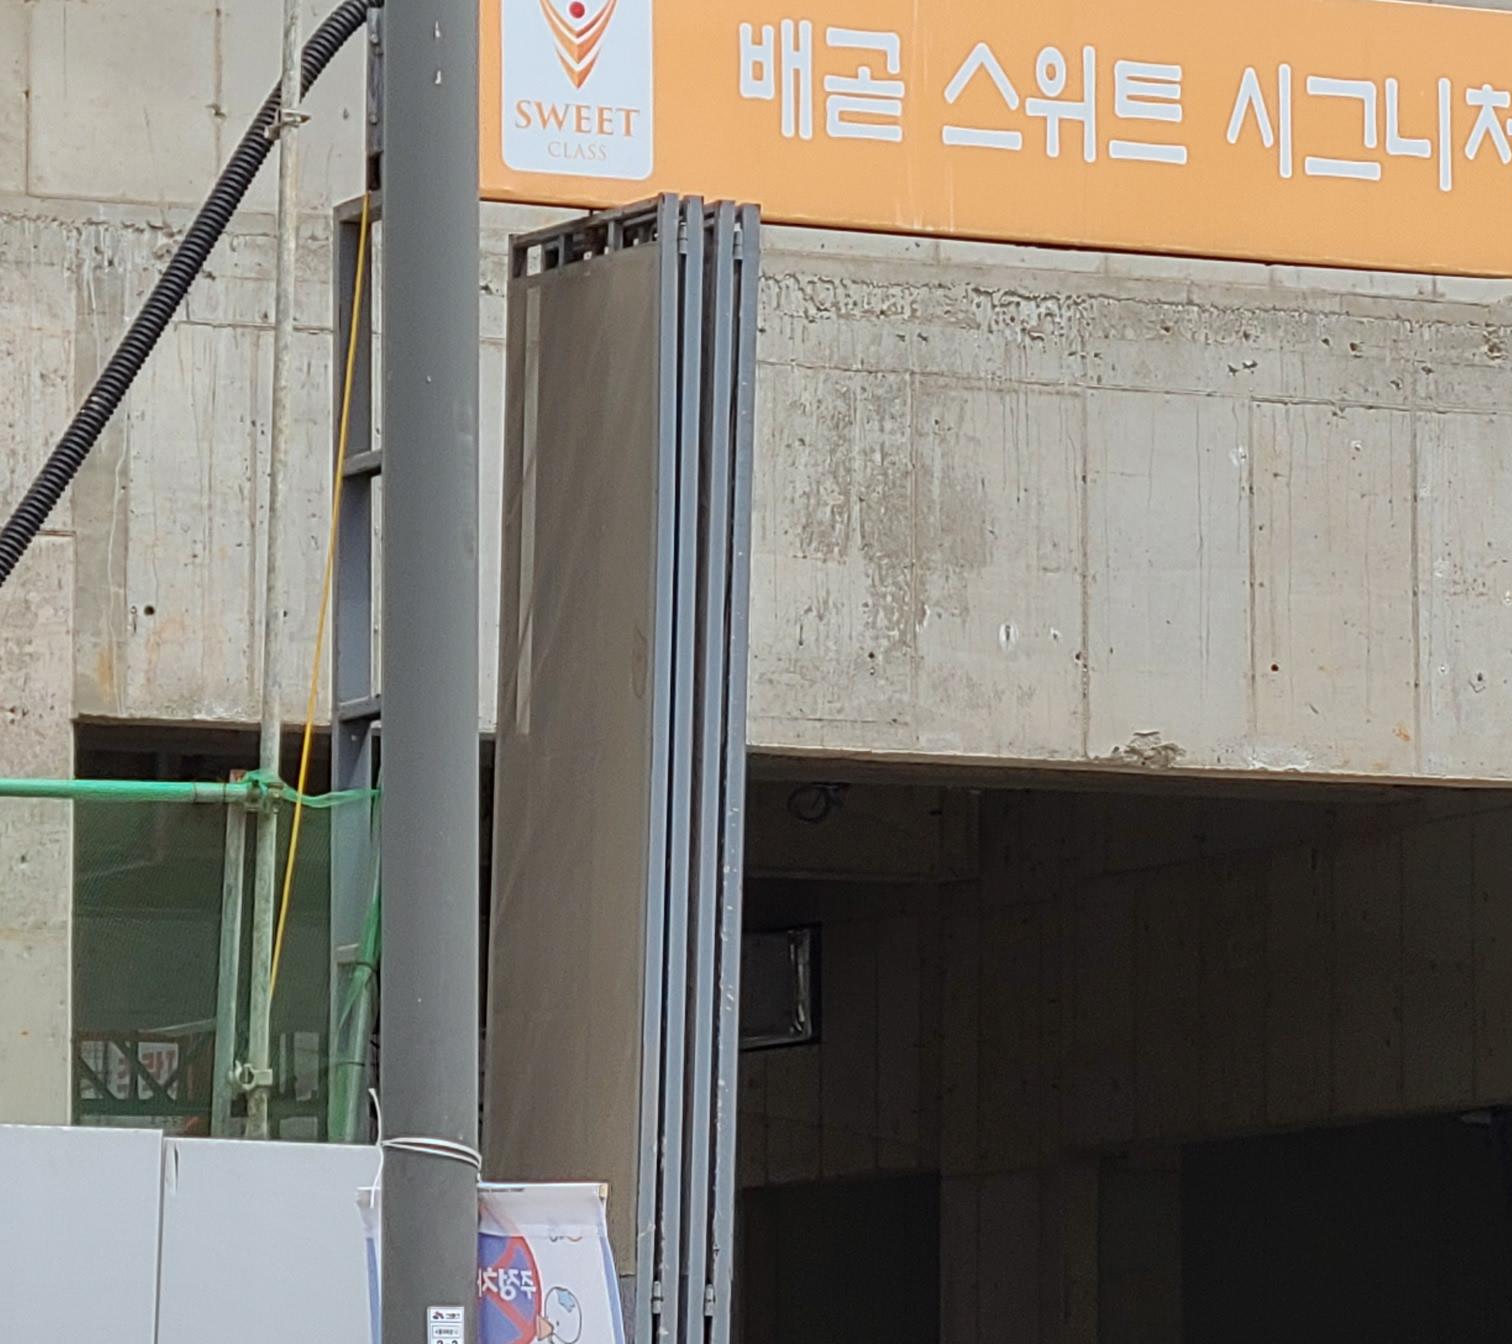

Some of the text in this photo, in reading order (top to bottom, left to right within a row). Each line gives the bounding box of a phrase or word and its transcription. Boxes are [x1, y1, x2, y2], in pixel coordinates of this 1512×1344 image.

[738, 18, 905, 143] 배곧
[941, 42, 1189, 165] 스위트
[514, 99, 641, 138] SWEET
[547, 141, 609, 160] CLASS
